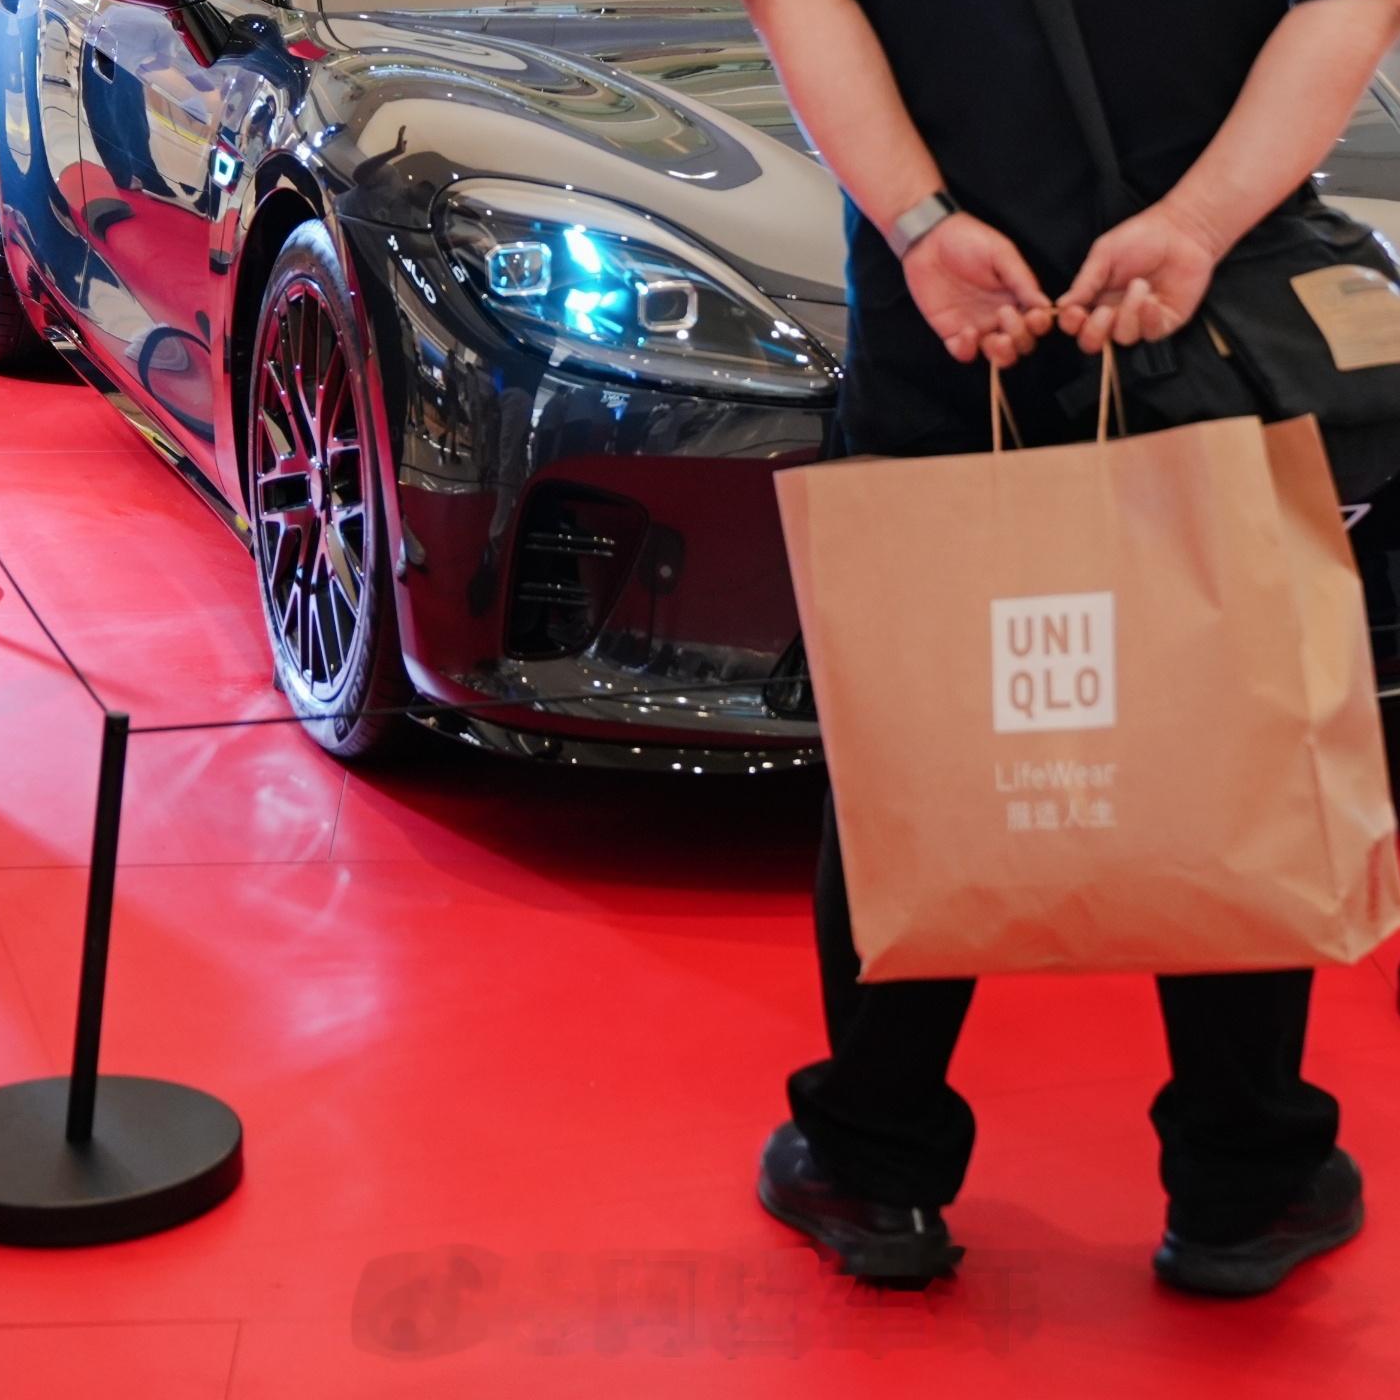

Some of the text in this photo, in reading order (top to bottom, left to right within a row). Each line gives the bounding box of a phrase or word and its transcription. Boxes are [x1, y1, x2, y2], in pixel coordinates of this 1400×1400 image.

[1007, 612, 1091, 658] UNI
[1009, 665, 1101, 721] QLO
[994, 760, 1117, 793] LifeWear
